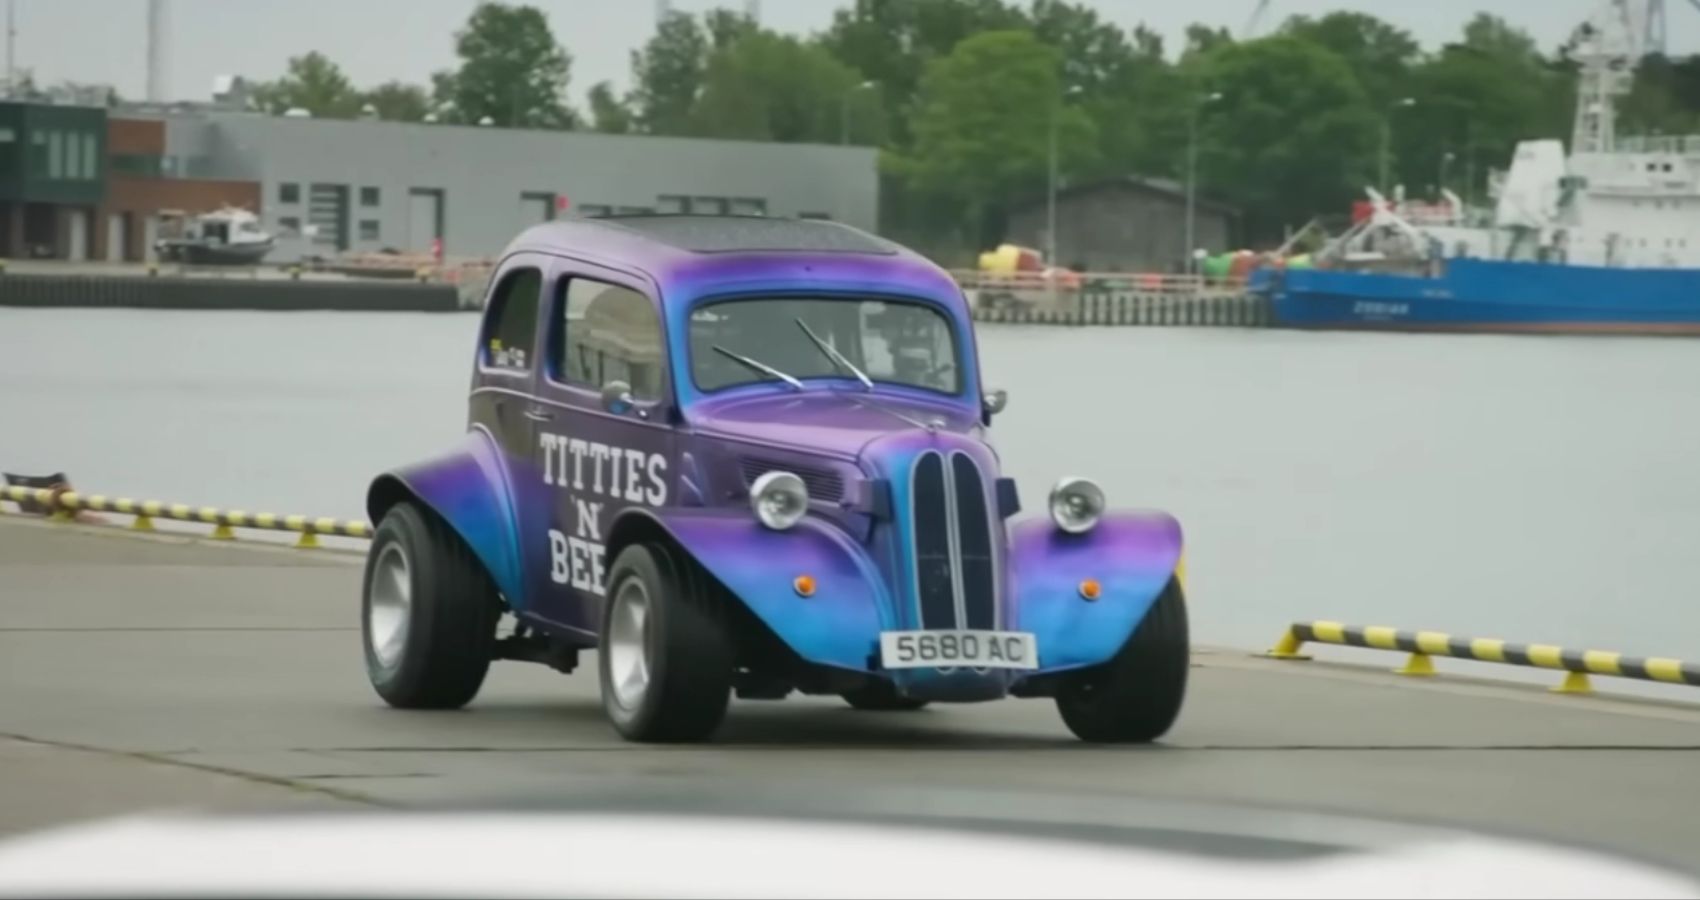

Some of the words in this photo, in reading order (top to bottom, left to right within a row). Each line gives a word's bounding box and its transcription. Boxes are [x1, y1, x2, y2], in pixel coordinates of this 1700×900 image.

[540, 432, 667, 506] TITTIES
[548, 529, 606, 596] BEE
[897, 634, 979, 661] 5680
[988, 636, 1022, 662] AC
